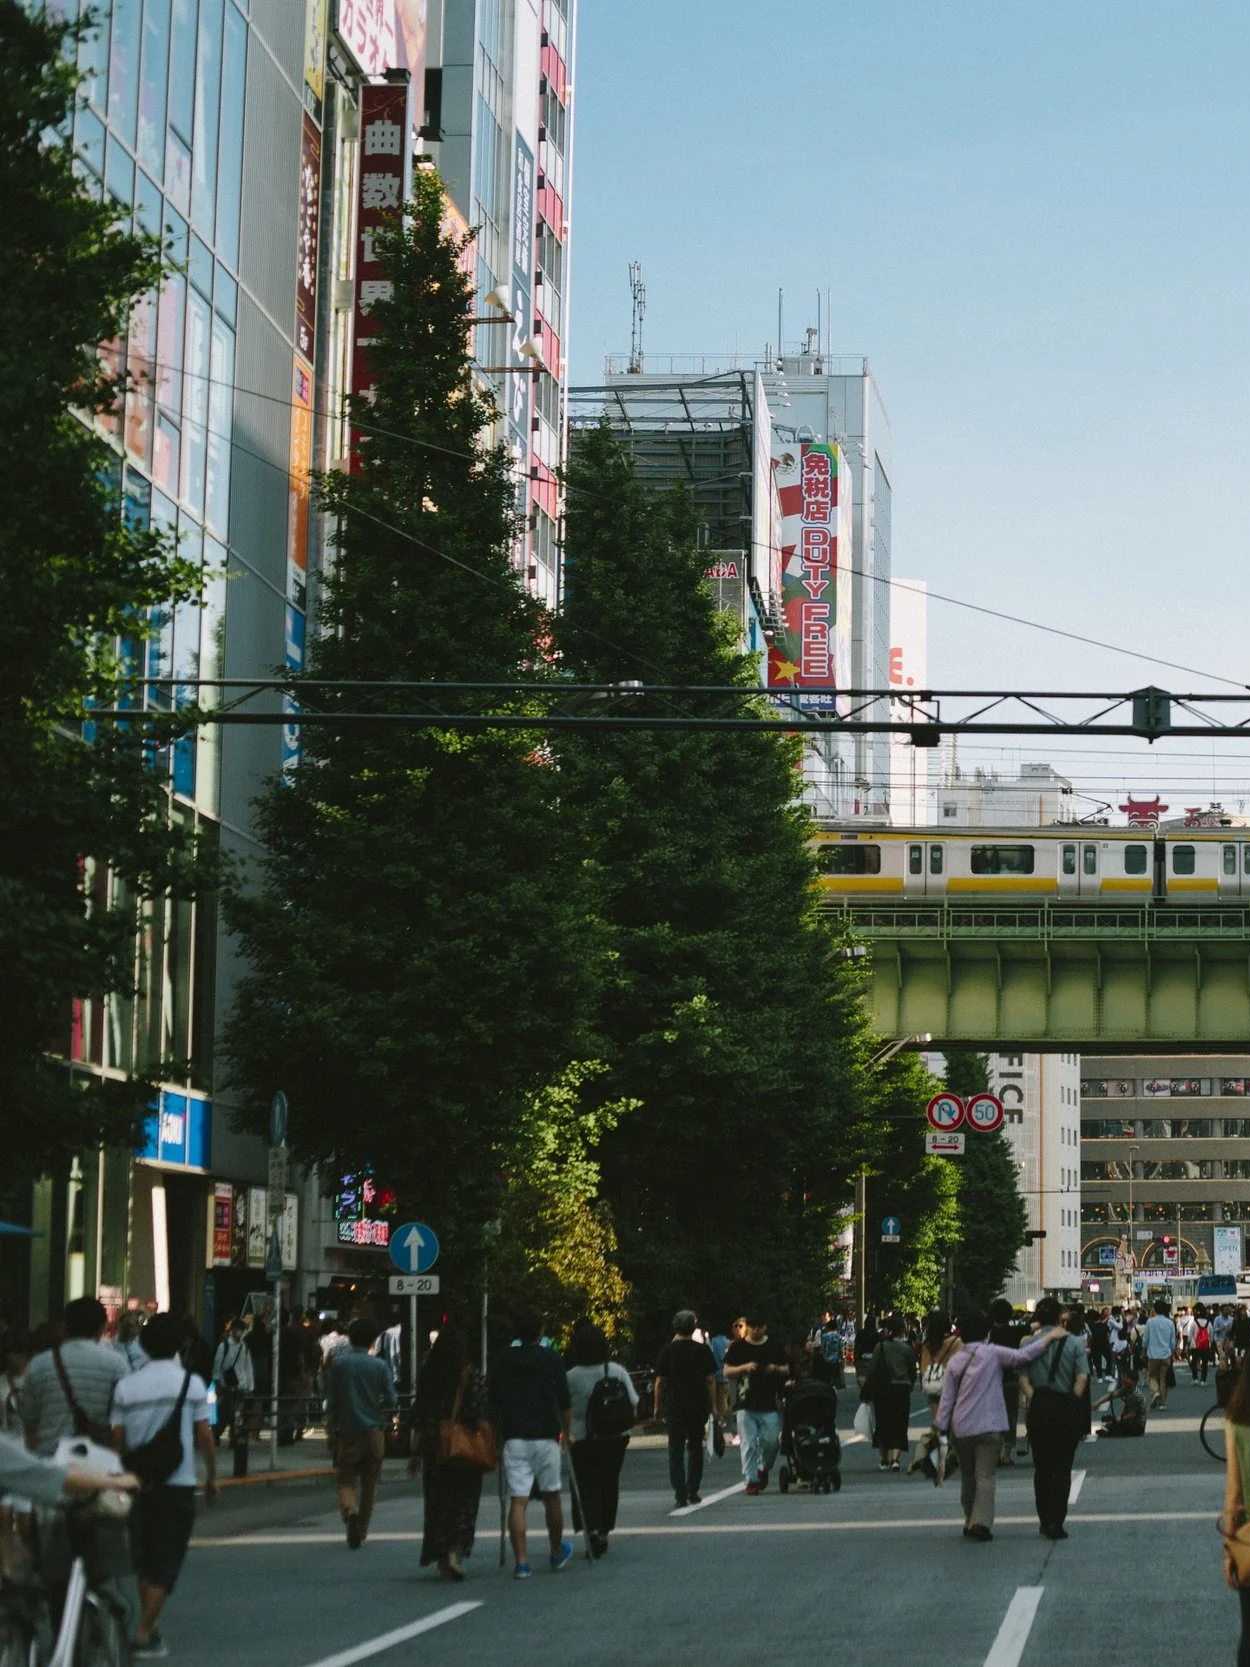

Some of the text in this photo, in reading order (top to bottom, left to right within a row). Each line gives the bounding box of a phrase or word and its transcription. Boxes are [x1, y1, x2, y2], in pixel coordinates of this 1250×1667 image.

[801, 451, 830, 523] 免税店
[801, 527, 830, 599] DUTY
[801, 603, 830, 678] FREE
[975, 1104, 996, 1121] 50
